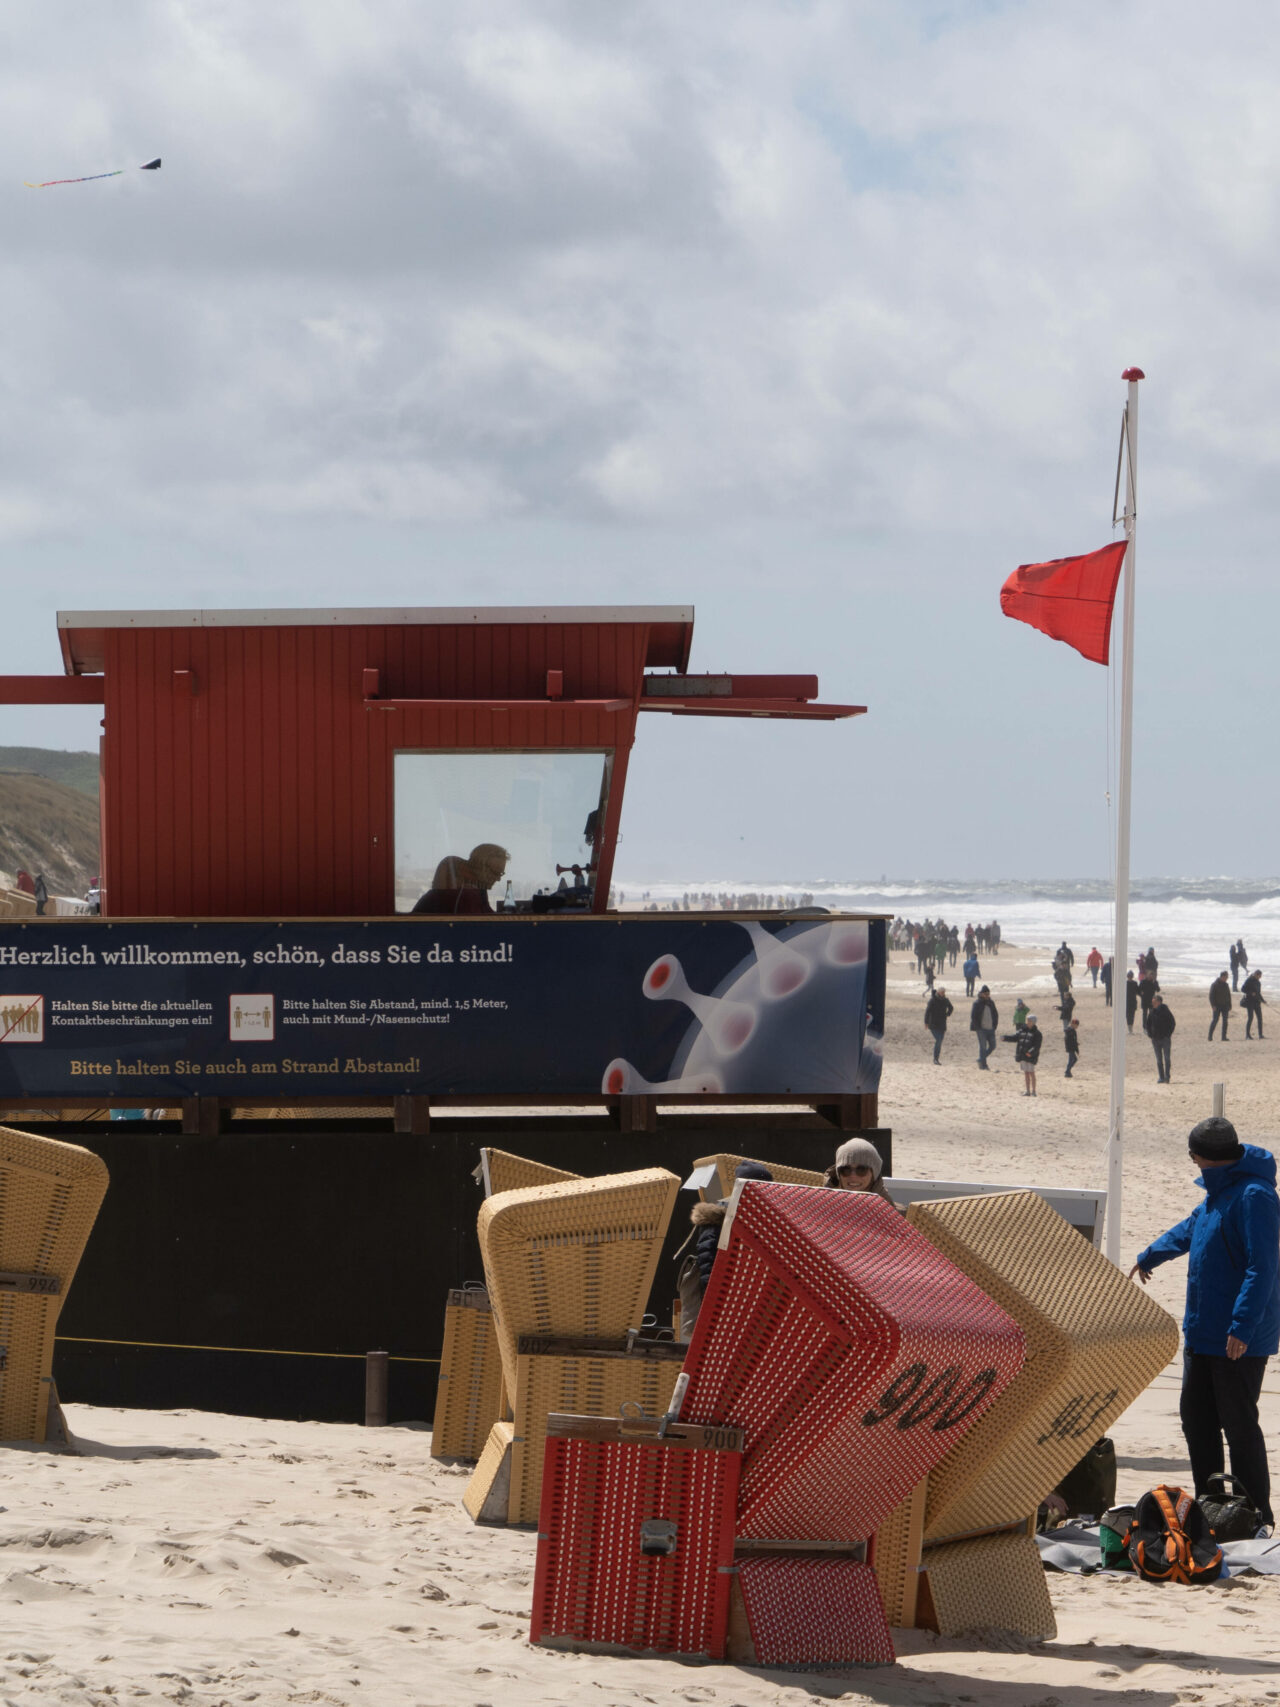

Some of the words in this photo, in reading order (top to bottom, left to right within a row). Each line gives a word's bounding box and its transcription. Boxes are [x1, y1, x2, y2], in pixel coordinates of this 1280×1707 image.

[0, 945, 96, 965] Herzlich
[101, 945, 247, 968] willkommen,
[253, 944, 325, 967] schön,
[331, 944, 381, 964] dass
[387, 944, 421, 964] Sie
[427, 943, 454, 963] da
[459, 943, 513, 963] sind!
[51, 1000, 90, 1011] Halten
[92, 1000, 109, 1011] Sie
[111, 1000, 139, 1011] bitte
[140, 1000, 158, 1011] die
[160, 1000, 213, 1010] aktuellen
[282, 1000, 310, 1010] Bitte
[312, 999, 347, 1010] halten
[349, 1000, 367, 1010] Sie
[369, 999, 419, 1011] Abstand,
[421, 998, 452, 1010] mind.
[454, 1000, 470, 1011] 1,5
[472, 998, 508, 1010] Meter,
[51, 1015, 189, 1027] Kontaktbeschränkungen
[191, 1014, 212, 1025] ein!
[282, 1014, 310, 1024] auch
[312, 1014, 332, 1024] mit
[333, 1013, 451, 1026] Mund-/Nasenschutz!
[70, 1060, 112, 1076] Bitte
[115, 1059, 171, 1075] halten
[174, 1060, 201, 1075] Sie
[205, 1058, 247, 1075] auch
[251, 1063, 277, 1074] am
[281, 1058, 340, 1074] Strand
[343, 1057, 421, 1073] Abstand!
[861, 1362, 997, 1431] 900
[703, 1430, 737, 1449] 900
